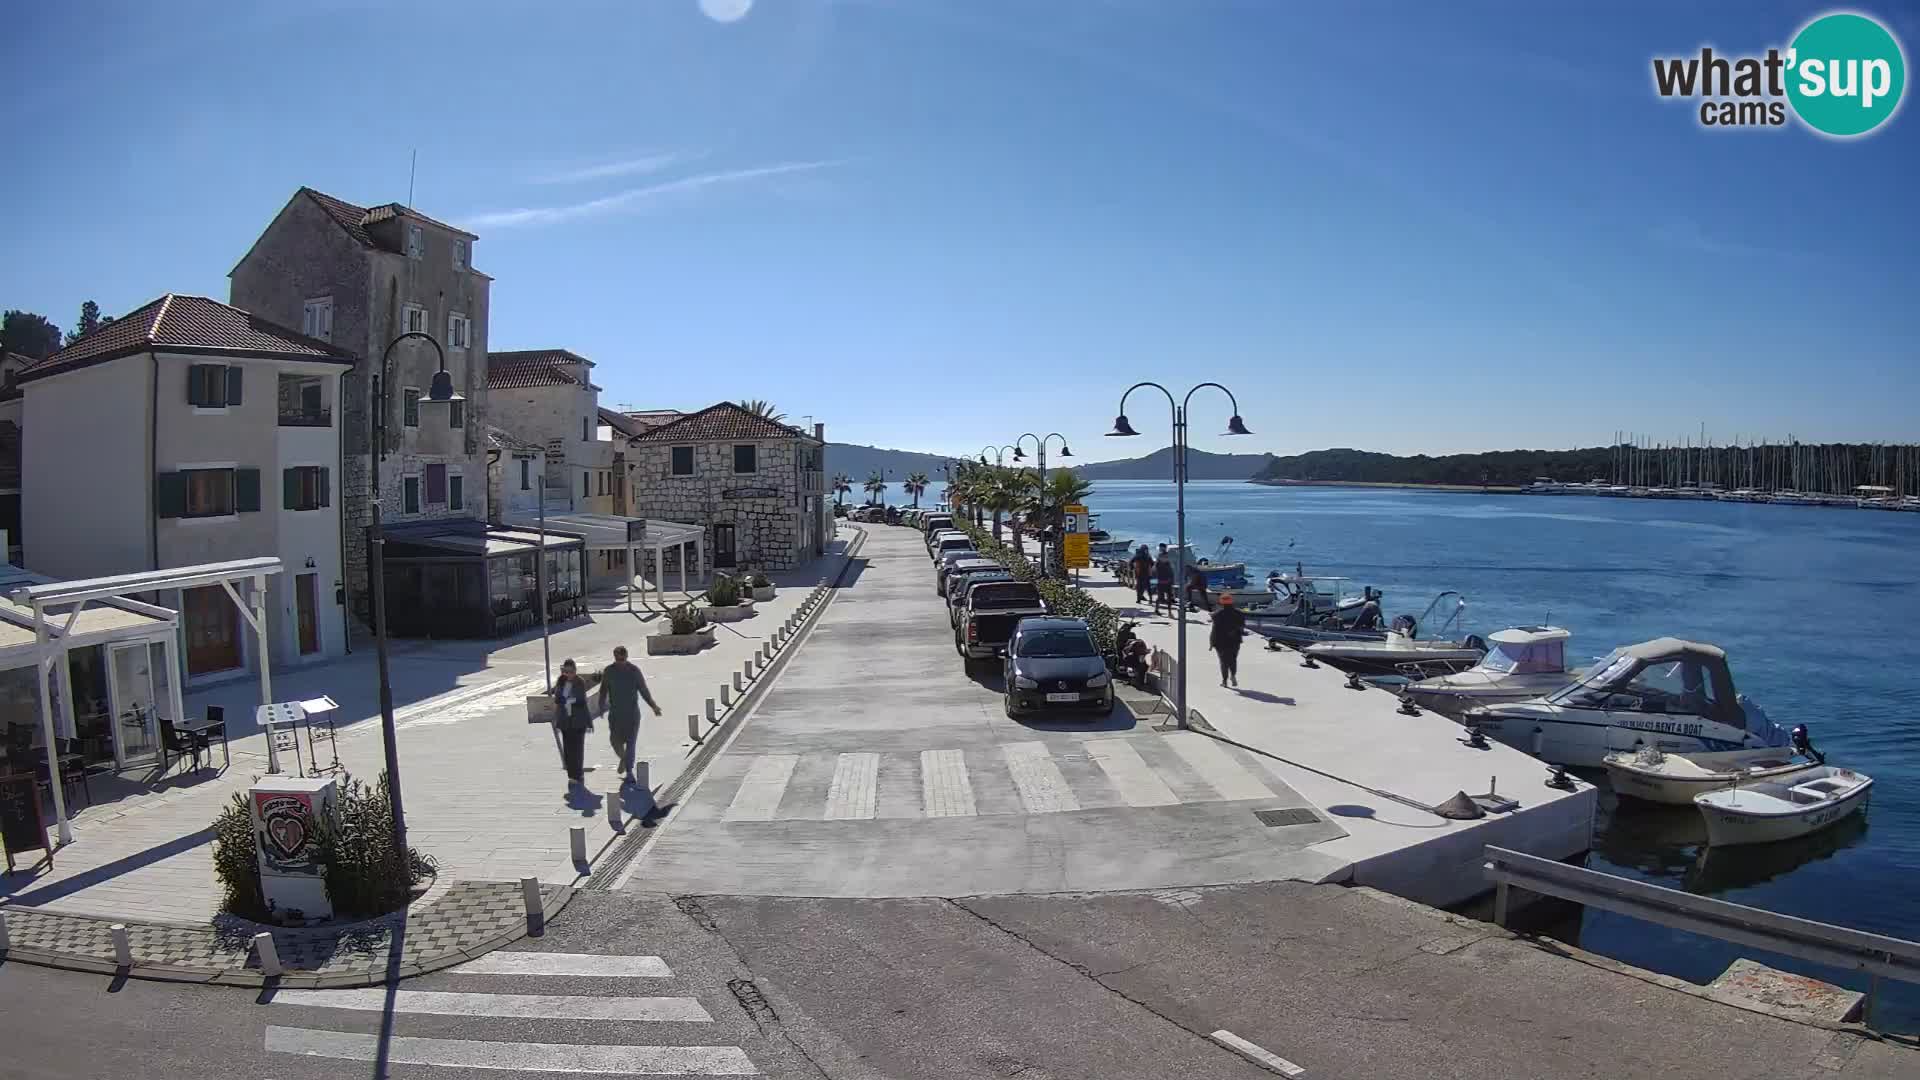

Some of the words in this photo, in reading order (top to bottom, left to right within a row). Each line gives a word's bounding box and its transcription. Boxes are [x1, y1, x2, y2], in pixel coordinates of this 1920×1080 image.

[1065, 515, 1076, 531] P
[1655, 722, 1676, 733] RENT
[1684, 724, 1703, 736] BOAT
